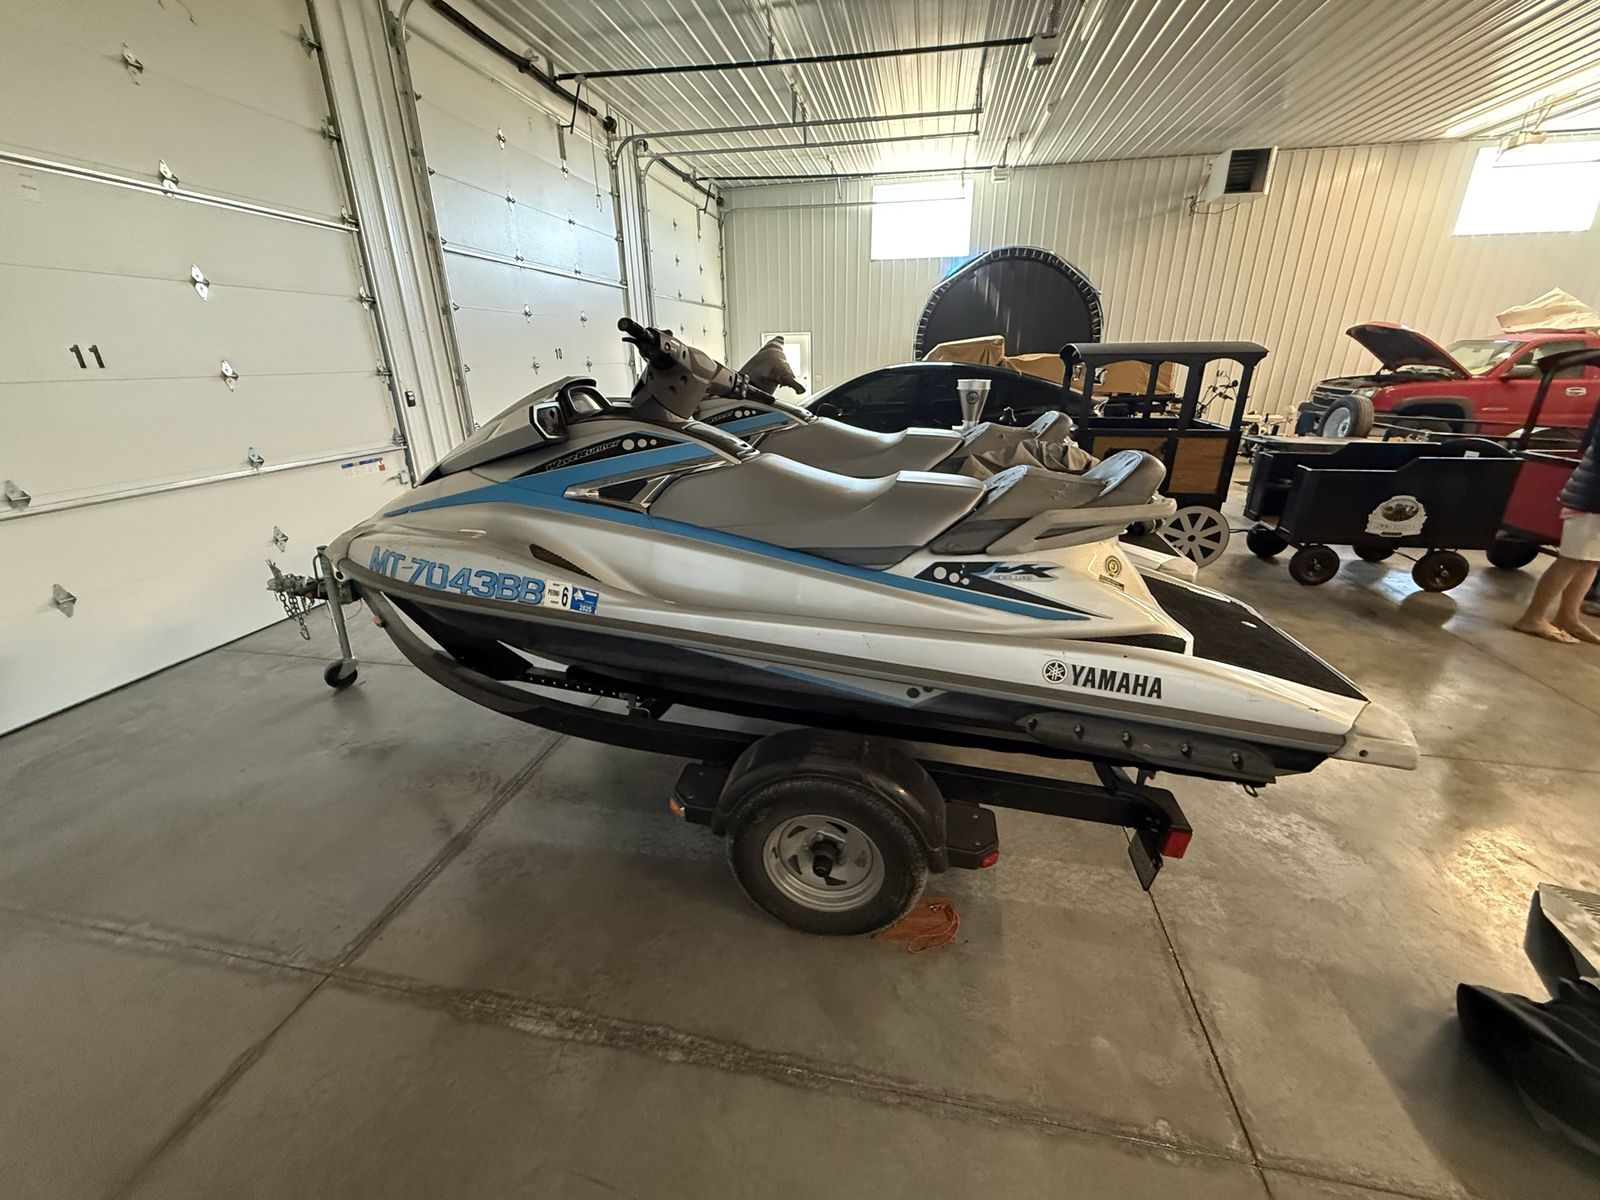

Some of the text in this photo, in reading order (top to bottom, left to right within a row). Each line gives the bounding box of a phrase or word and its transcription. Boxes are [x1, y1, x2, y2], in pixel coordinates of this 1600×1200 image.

[69, 344, 106, 369] 11
[554, 347, 563, 360] 10
[369, 545, 545, 606] MT-7043BB
[561, 586, 569, 607] 6
[1071, 664, 1162, 699] YAMAHA
